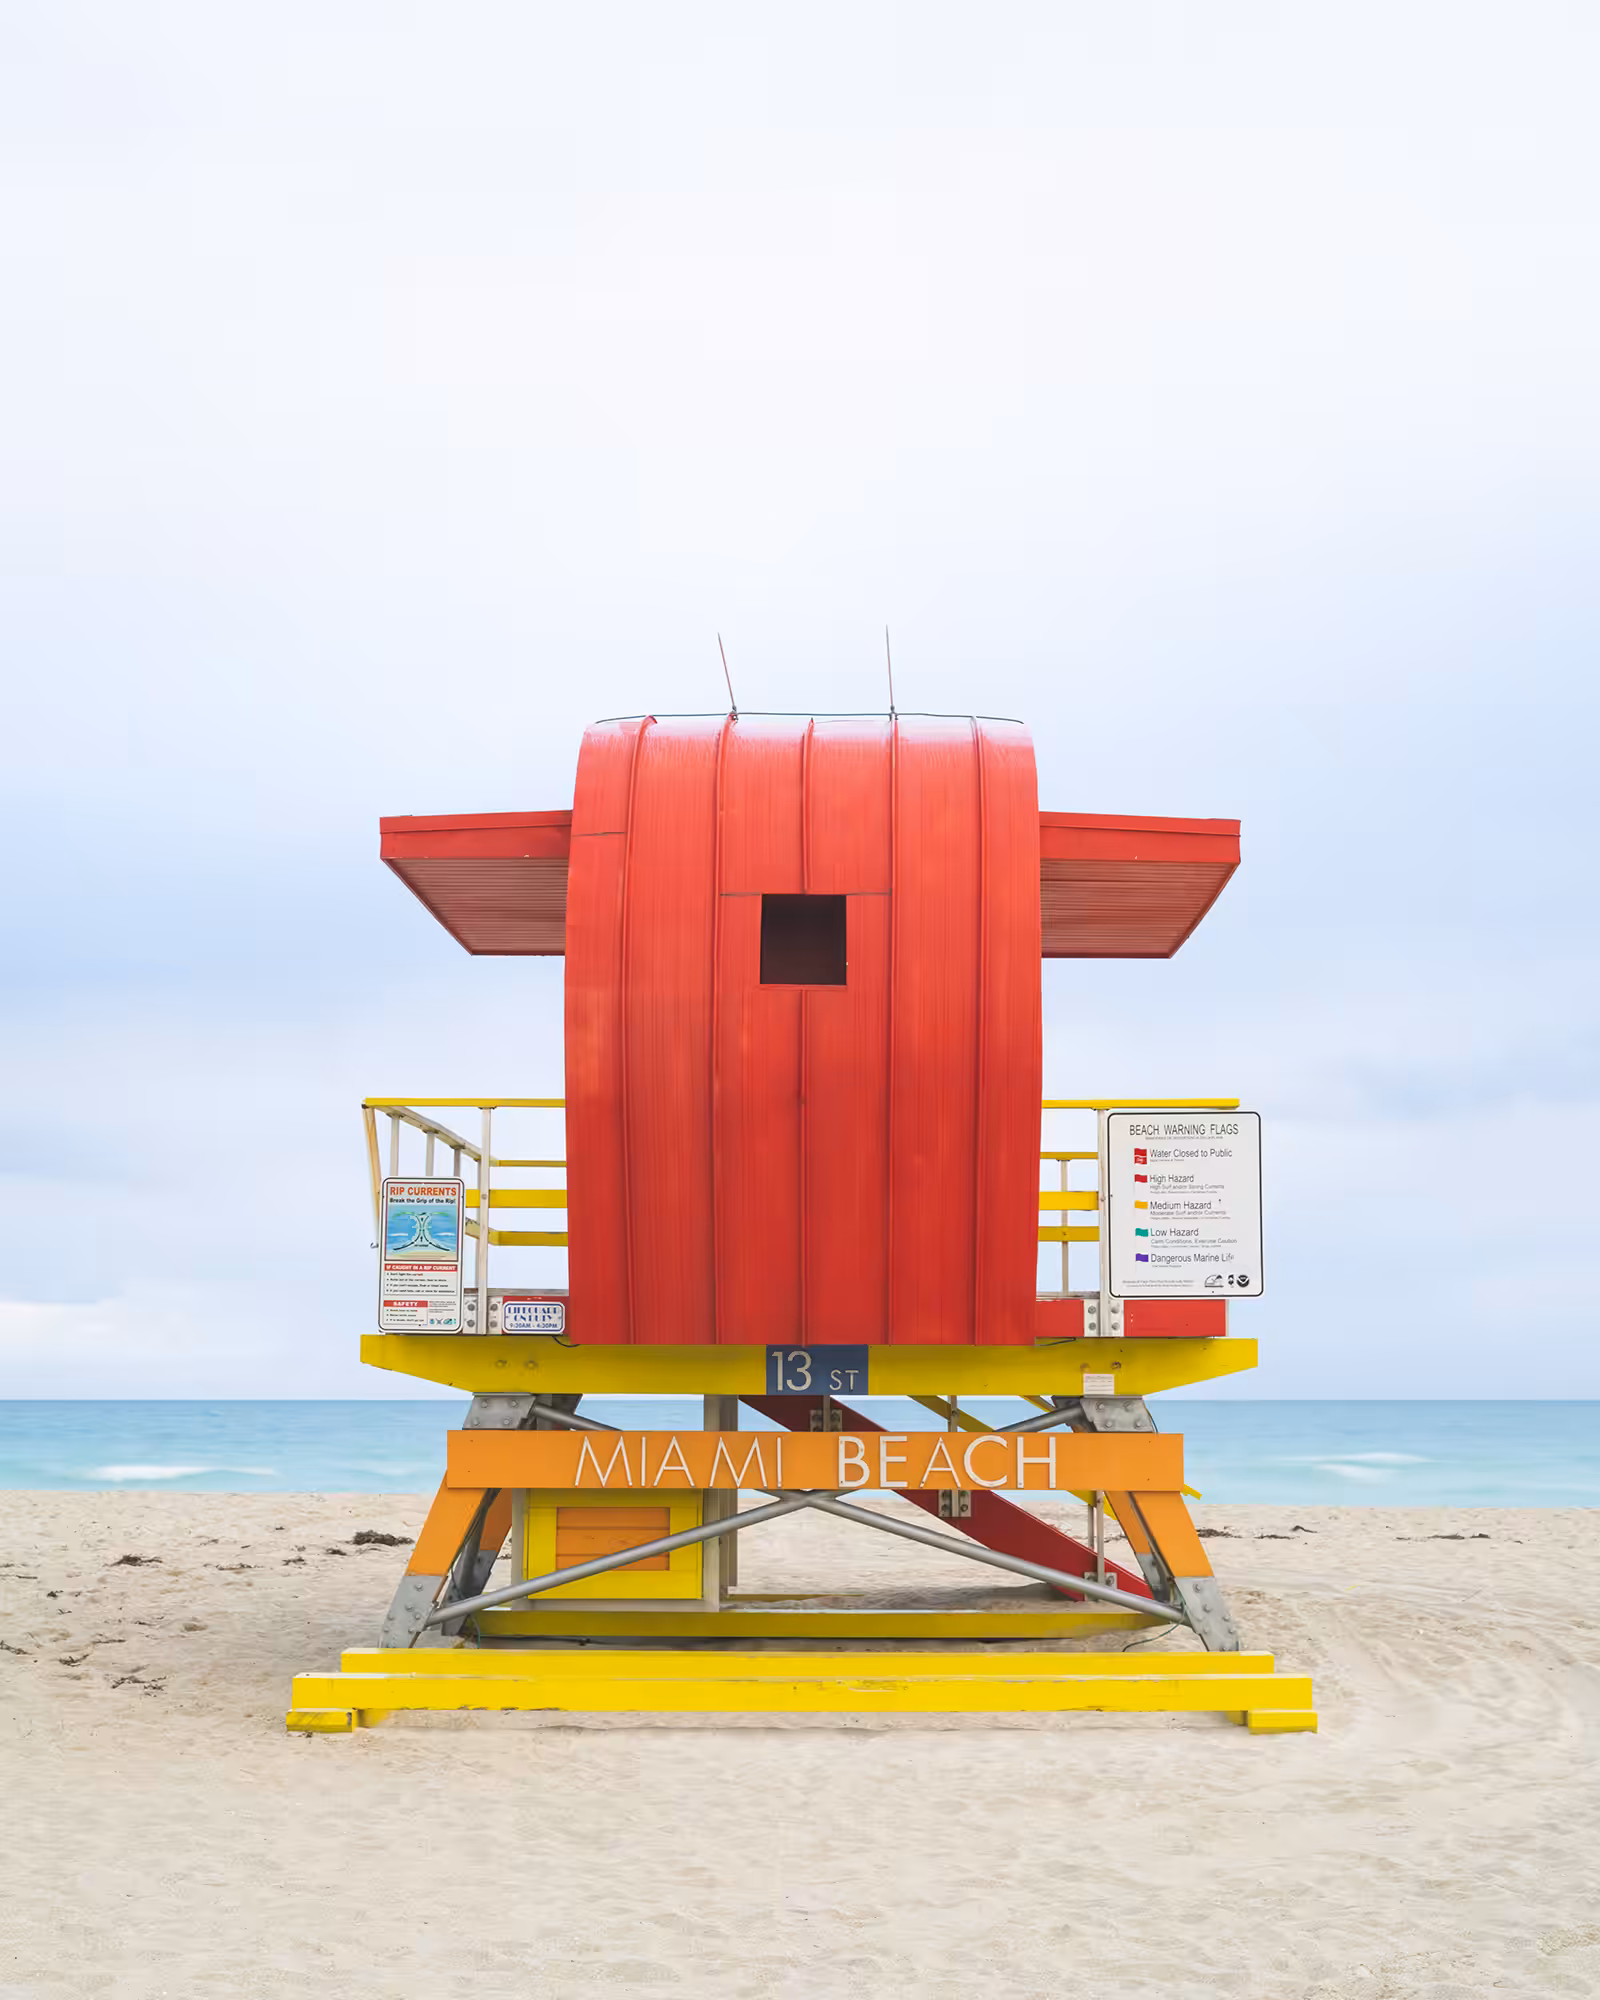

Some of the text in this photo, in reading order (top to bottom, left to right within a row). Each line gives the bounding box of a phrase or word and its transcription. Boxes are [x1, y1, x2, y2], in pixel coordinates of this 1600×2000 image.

[1129, 1124, 1239, 1135] BEACH WARNING FLAGS
[1150, 1149, 1233, 1158] Water Closed to Public
[1150, 1175, 1194, 1185] High Hazard
[390, 1186, 457, 1196] RIP CURRENTS
[1150, 1201, 1212, 1209] Medium Hazard
[1150, 1228, 1199, 1236] Low Hazard
[1151, 1253, 1191, 1264] Dangerous
[1193, 1253, 1219, 1262] Marine
[771, 1351, 860, 1391] 13 ST
[575, 1434, 1057, 1489] MIAMI BEACH
